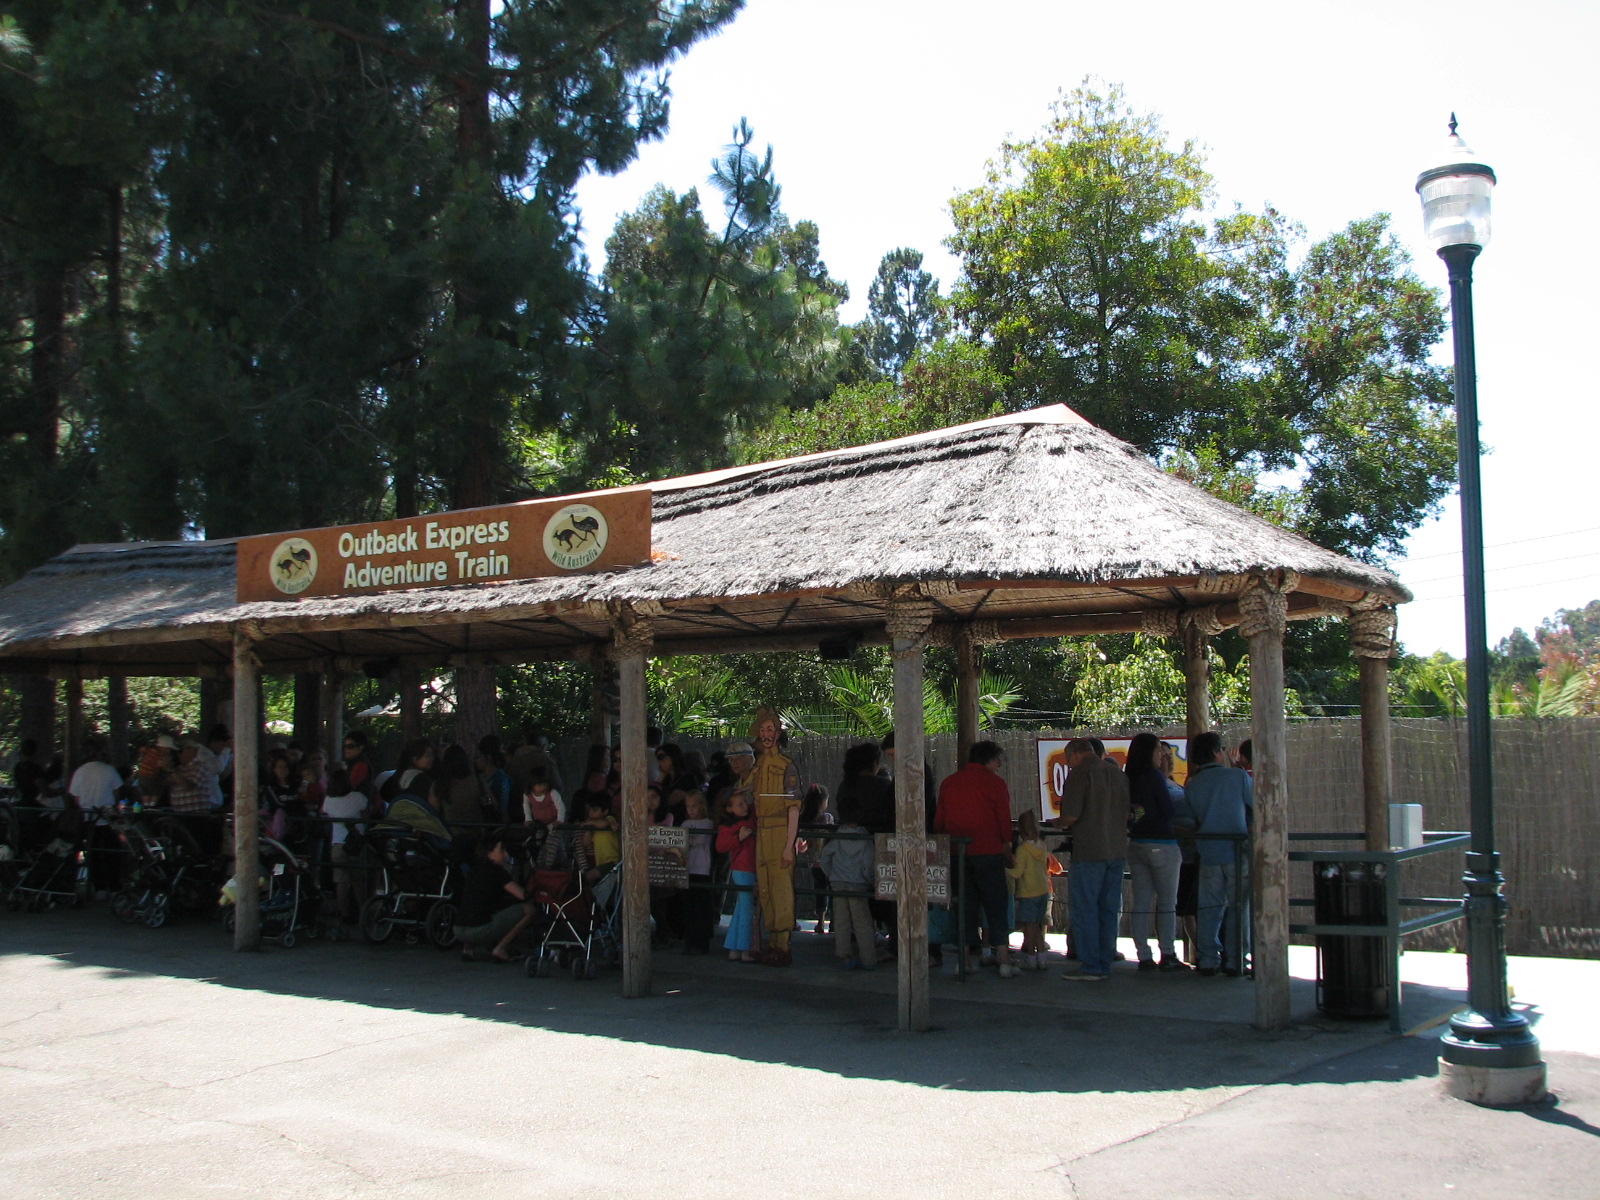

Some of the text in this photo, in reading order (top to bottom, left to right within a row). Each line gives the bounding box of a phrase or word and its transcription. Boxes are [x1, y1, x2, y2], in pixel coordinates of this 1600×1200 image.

[338, 520, 510, 558] Outback Express
[552, 549, 598, 568] Wild Australia
[343, 549, 509, 589] Adventure Train
[659, 828, 684, 837] Express
[668, 837, 684, 845] Train
[880, 866, 946, 878] THE ACK
[880, 882, 946, 895] STA ERE
